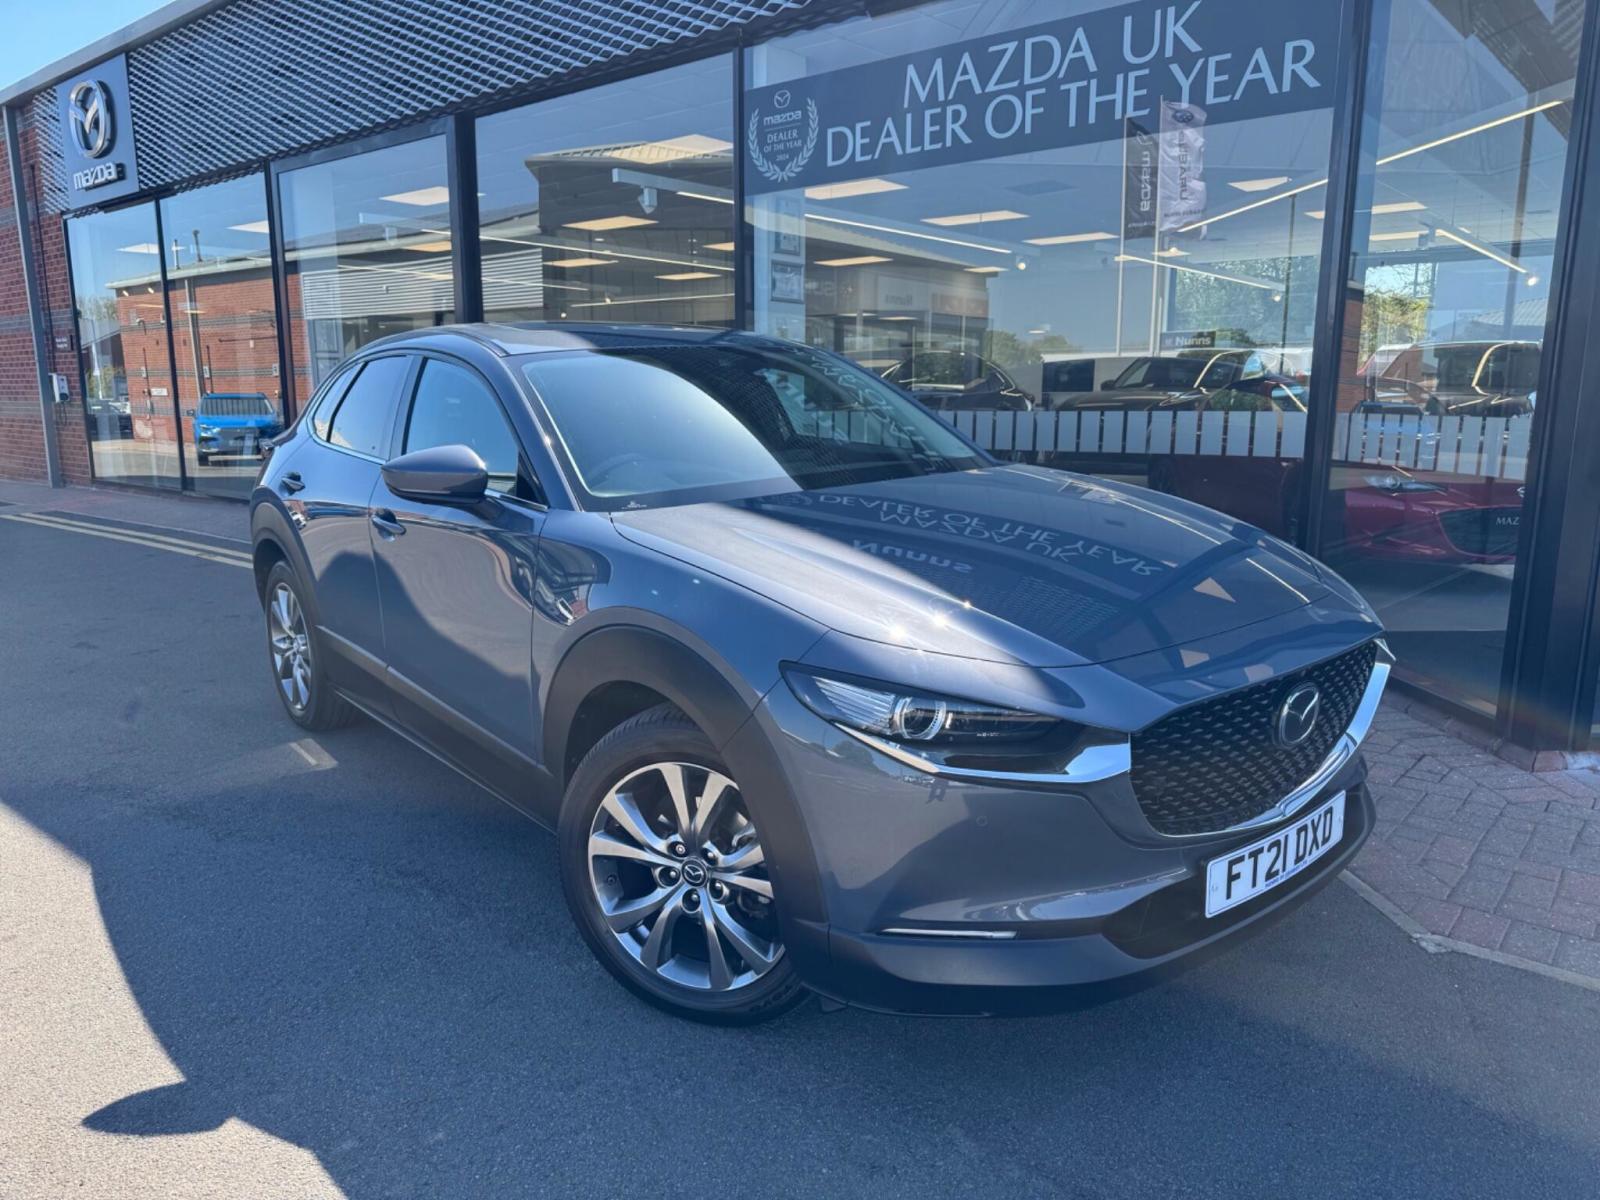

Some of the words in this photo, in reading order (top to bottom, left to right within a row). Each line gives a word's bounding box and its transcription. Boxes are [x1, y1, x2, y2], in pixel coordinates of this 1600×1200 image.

[904, 27, 1098, 108] MAZDA
[1123, 1, 1202, 64] UK
[827, 104, 972, 167] DEALER
[985, 88, 1046, 139] OF
[1060, 68, 1150, 127] THE
[1169, 39, 1321, 108] YEAR
[764, 110, 802, 126] mazda
[767, 129, 798, 143] DEALER
[786, 139, 802, 149] YEAR
[73, 162, 117, 190] mazda
[1140, 151, 1151, 211] mazda
[1175, 336, 1211, 346] Nunns
[1496, 516, 1520, 526] MAZ
[1225, 834, 1289, 900] FT21
[1294, 806, 1333, 866] DXD
